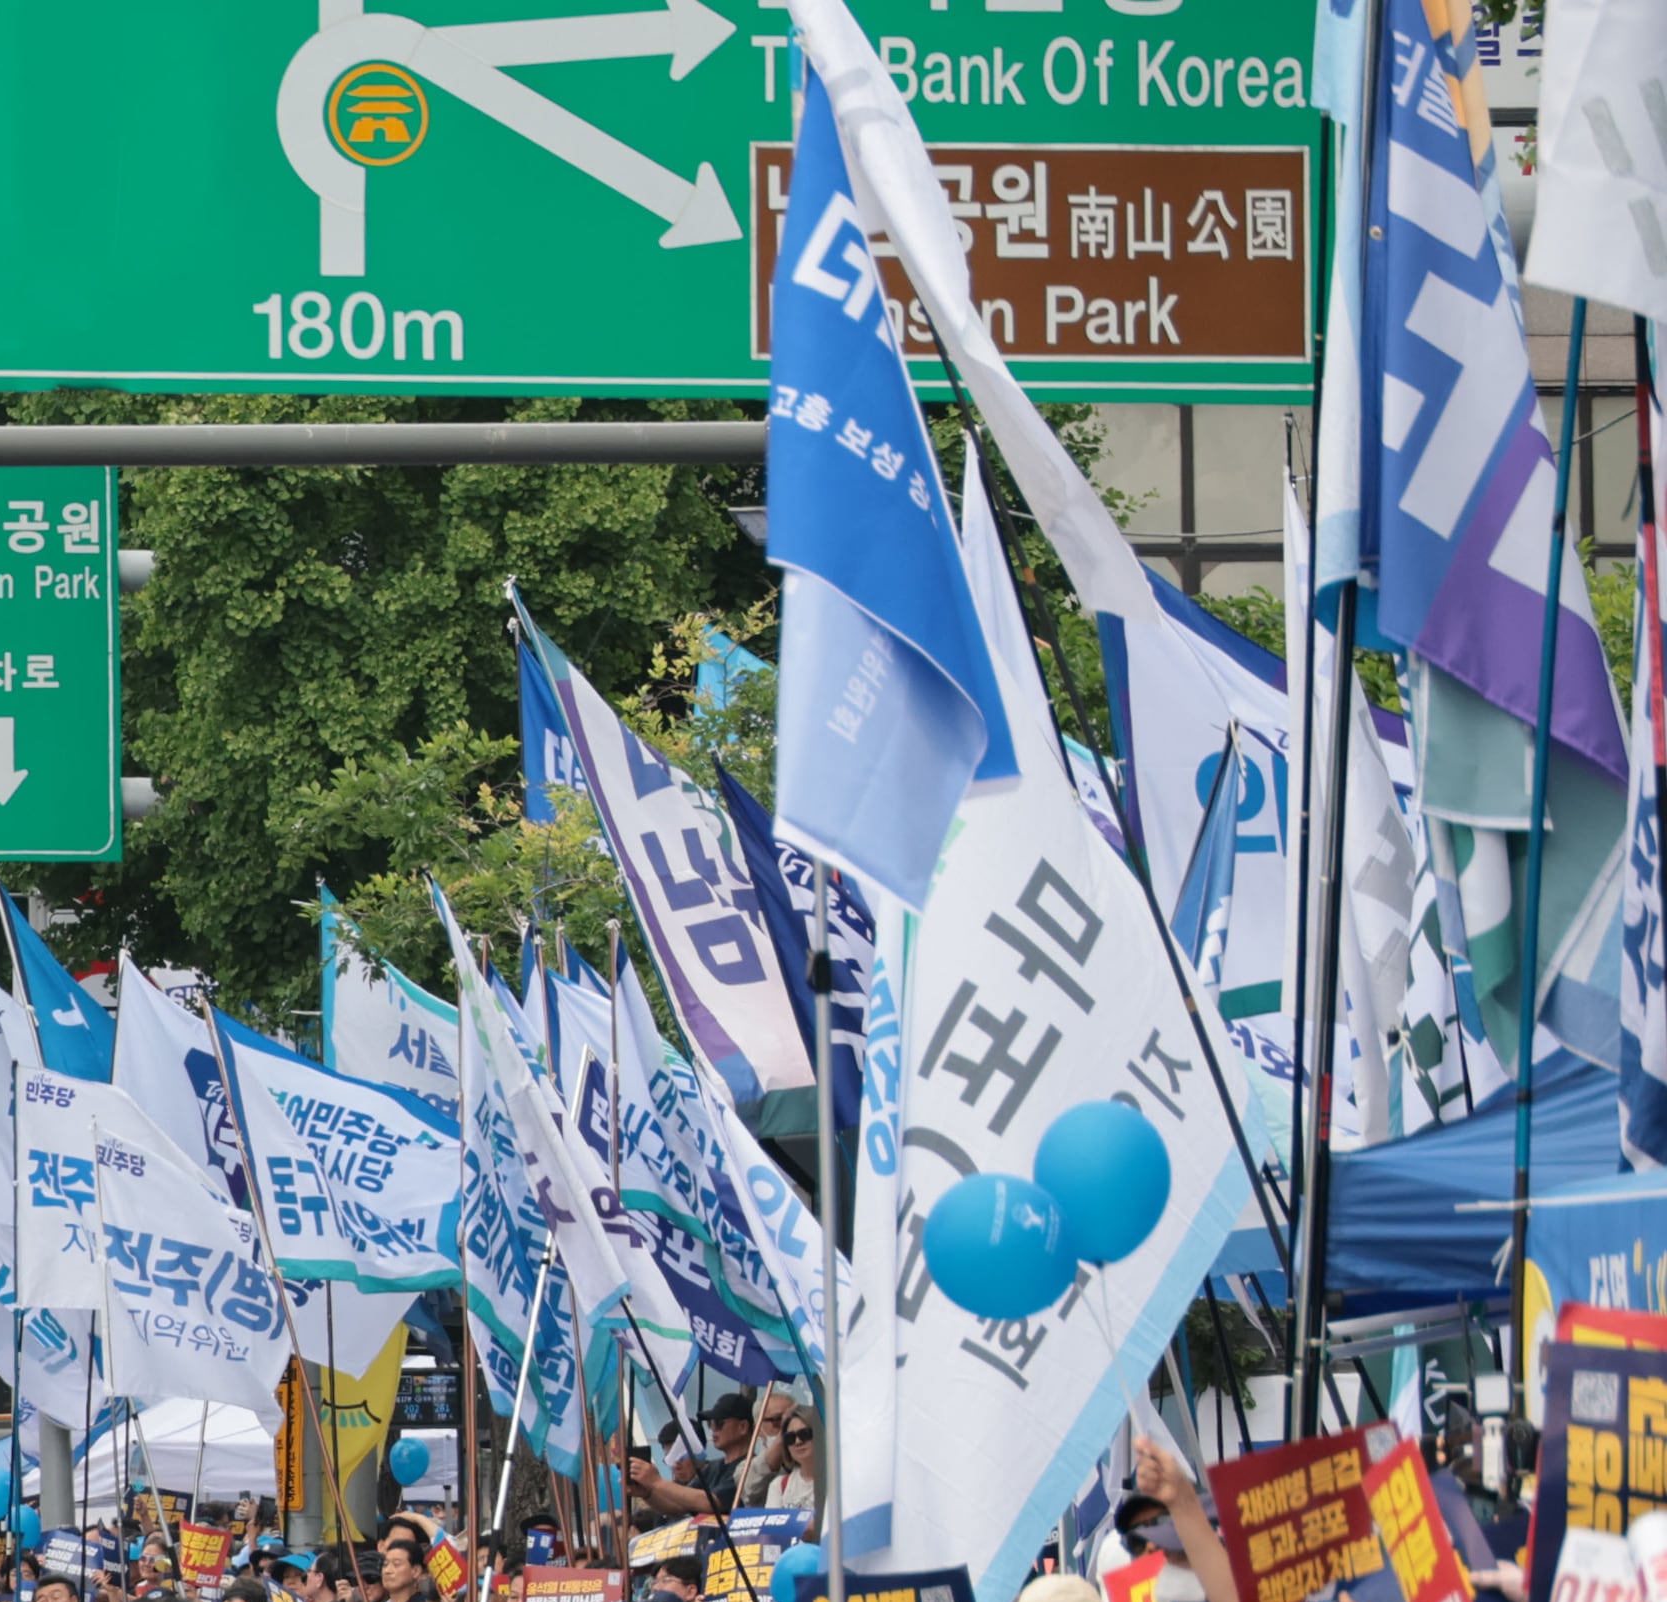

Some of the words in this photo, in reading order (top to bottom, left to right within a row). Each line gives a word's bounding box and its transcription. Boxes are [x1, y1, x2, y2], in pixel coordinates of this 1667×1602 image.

[879, 37, 1026, 105] Bank
[1043, 38, 1113, 104] Of
[1138, 39, 1310, 107] Korea
[1068, 186, 1292, 260] 南山公園
[253, 291, 464, 361] 180m
[1045, 276, 1180, 344] Park
[835, 417, 904, 481] 보성
[35, 567, 101, 600] Park
[26, 1082, 75, 1108] 민주당
[28, 1149, 95, 1217] 전주
[1310, 1448, 1362, 1492] 특검
